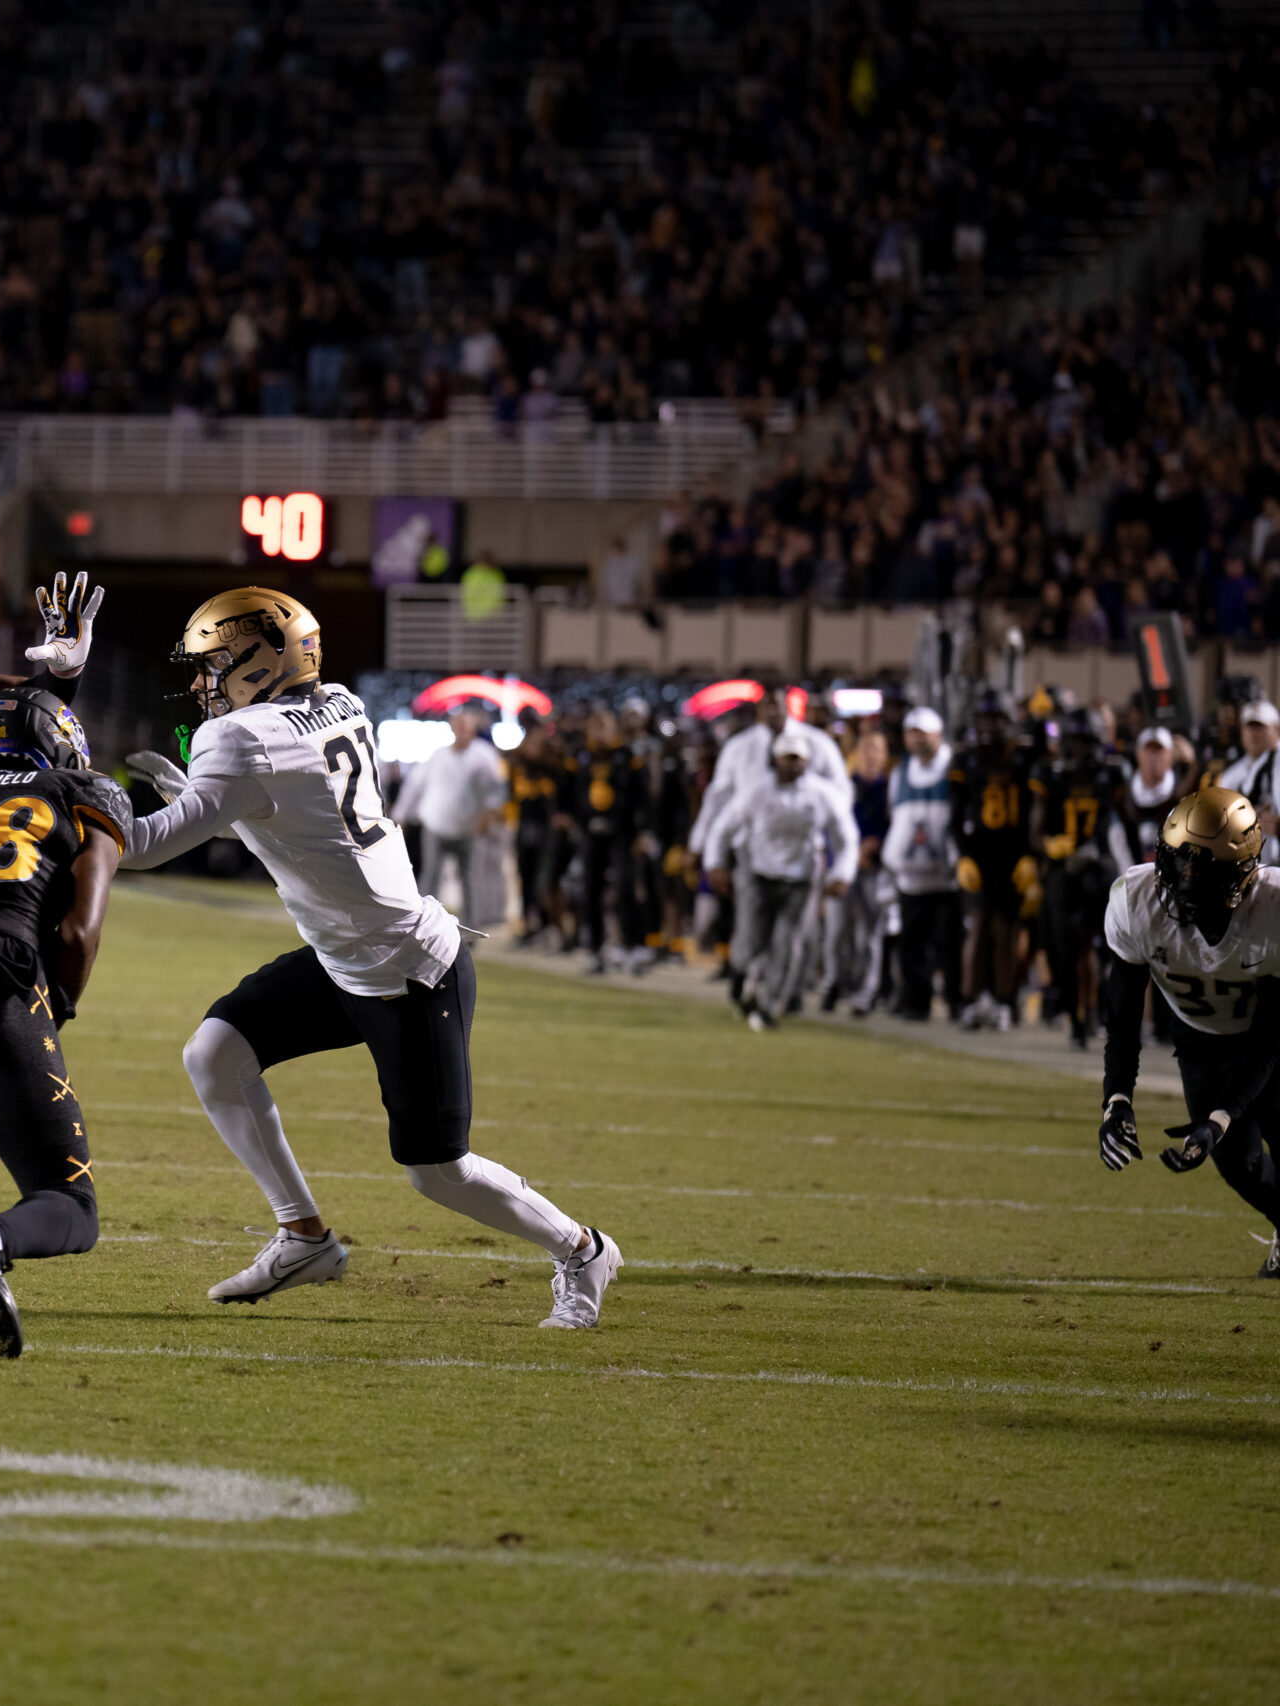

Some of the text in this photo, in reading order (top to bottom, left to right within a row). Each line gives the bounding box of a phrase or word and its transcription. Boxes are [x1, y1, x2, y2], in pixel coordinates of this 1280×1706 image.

[241, 492, 324, 561] 40
[215, 611, 278, 642] UCF
[323, 725, 387, 851] 21
[980, 781, 1020, 831] 81
[1164, 972, 1256, 1020] 37
